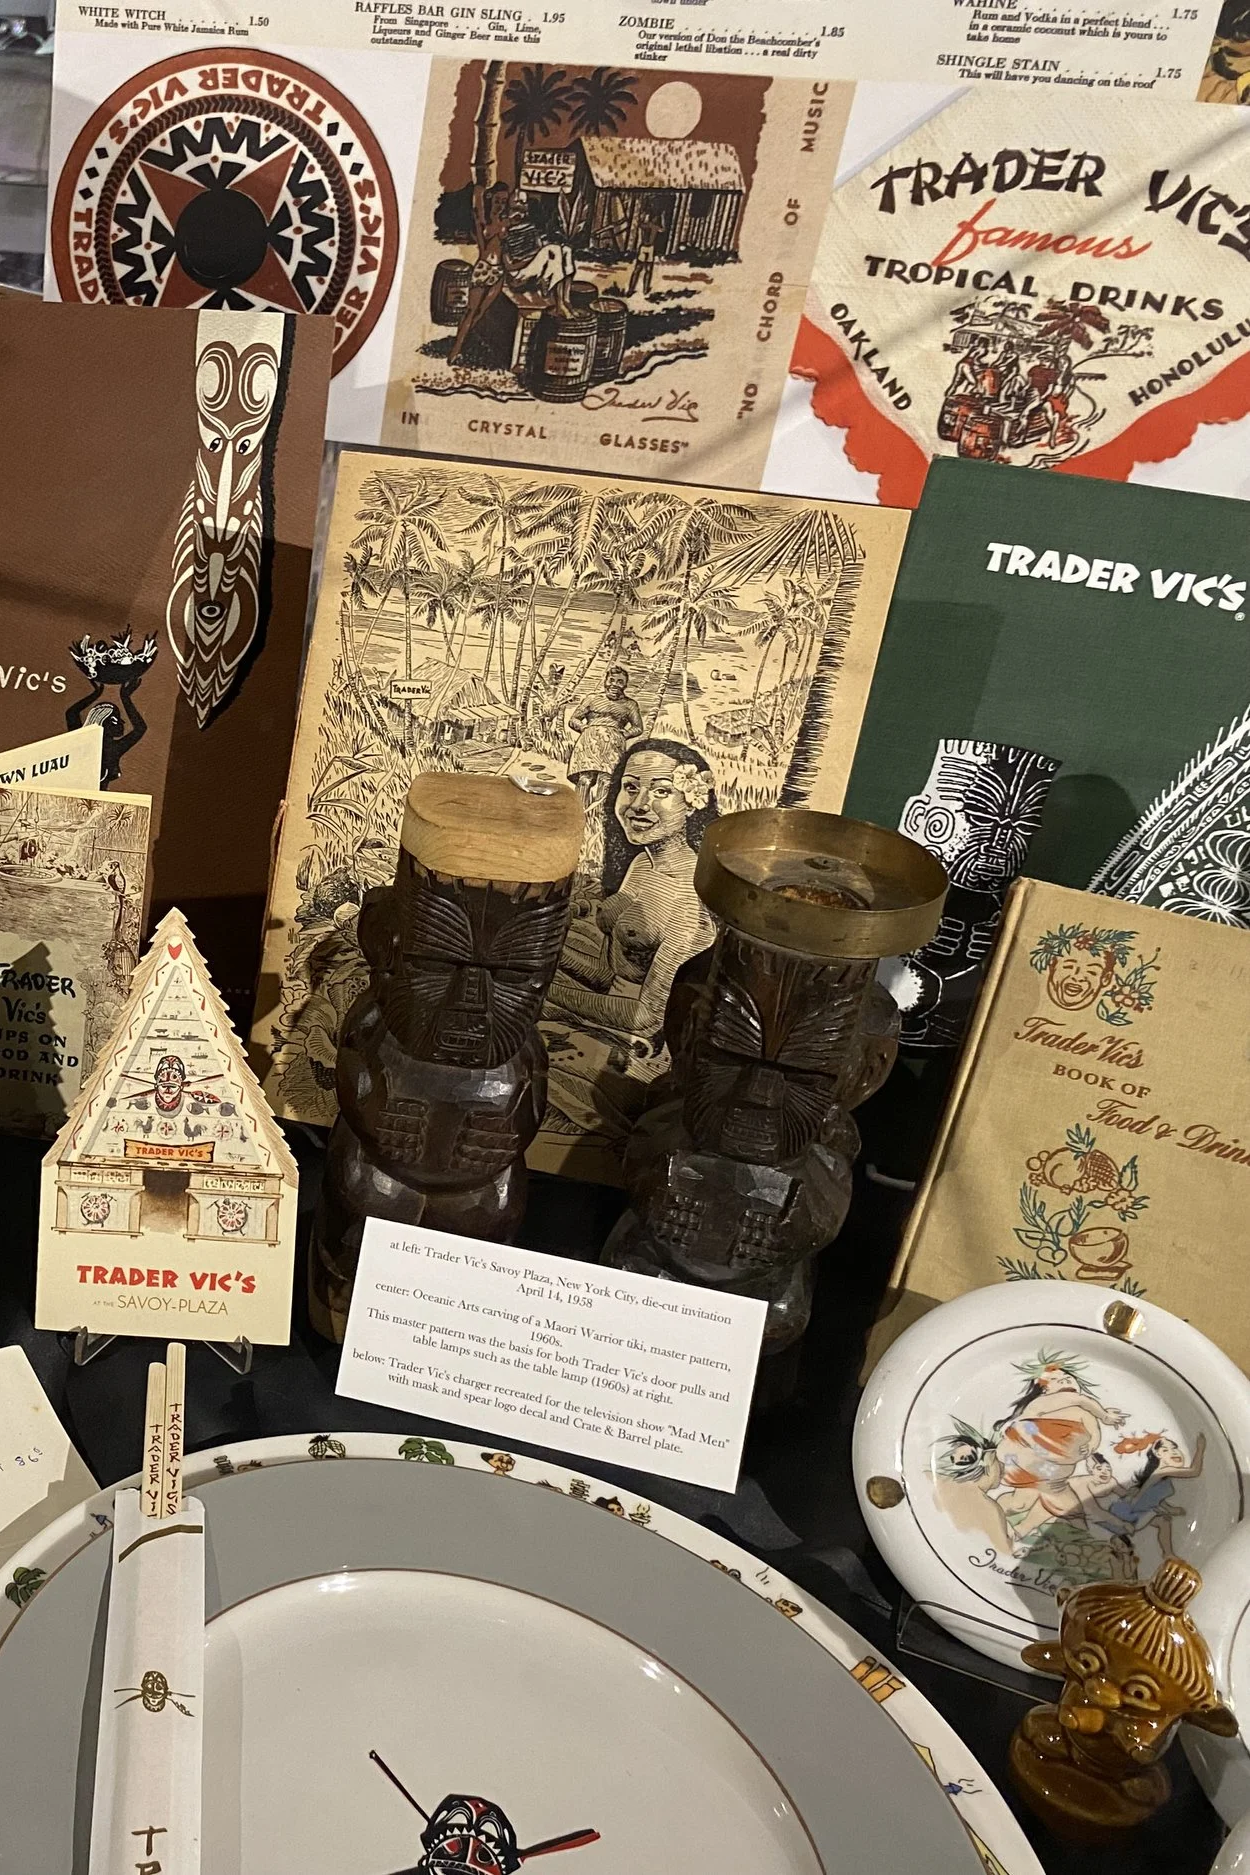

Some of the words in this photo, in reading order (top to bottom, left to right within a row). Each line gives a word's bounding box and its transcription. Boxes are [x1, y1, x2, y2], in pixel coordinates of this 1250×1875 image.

[78, 6, 119, 19] WHITE
[125, 8, 166, 21] WITCH
[249, 16, 269, 27] 1.50
[355, 2, 412, 15] RAFFLES
[418, 5, 444, 17] BAR
[450, 7, 475, 19] GIN
[480, 9, 522, 21] SLING
[542, 12, 565, 23] 1.95
[619, 15, 675, 30] ZOMBIE
[820, 26, 845, 38] 1.85
[936, 54, 1007, 69] SHINGLE
[1012, 59, 1060, 71] STAIN
[1155, 68, 1182, 79] 1.75
[959, 68, 981, 79] This
[984, 69, 1003, 80] will
[1005, 71, 1029, 82] have
[1033, 74, 1052, 85] you
[1054, 74, 1095, 87] dancing
[1098, 78, 1111, 87] on
[1114, 78, 1130, 88] the
[1133, 79, 1156, 89] roof
[870, 147, 1106, 215] TRADER
[931, 197, 1152, 267] famous
[737, 383, 758, 421] "NO
[756, 271, 784, 343] CHORD
[784, 197, 801, 226] OF
[799, 82, 828, 154] MUSIC
[864, 254, 1039, 297] TROPICAL
[1069, 281, 1224, 321] DRINKS
[830, 302, 913, 411] OAKLAND
[1128, 318, 1250, 406] HONOLULU
[401, 411, 419, 427] IN
[467, 419, 547, 440] CRYSTAL
[599, 433, 690, 454] GLASSES"
[986, 542, 1141, 594] TRADER
[1150, 568, 1247, 612] VIC'S
[32, 754, 70, 778] LUAU
[38, 1034, 67, 1048] ON
[1013, 1016, 1100, 1057] Trader
[1099, 1035, 1144, 1070] Vic's
[39, 1052, 79, 1068] AND
[1053, 1063, 1116, 1090] BOOK
[1121, 1082, 1151, 1099] OF
[1086, 1098, 1160, 1135] Food
[1154, 1122, 1178, 1140] &
[136, 1146, 175, 1156] TRADER
[178, 1147, 203, 1158] VIC'S
[77, 1265, 178, 1289] TRADER
[190, 1270, 257, 1294] VIC'S
[390, 1241, 399, 1250] at
[401, 1241, 421, 1254] left:
[425, 1246, 461, 1263] Trader
[464, 1255, 486, 1269] Vic's
[488, 1261, 520, 1279] Savoy
[522, 1267, 553, 1286] Plaza,
[555, 1275, 581, 1290] New
[585, 1281, 611, 1297] York
[614, 1289, 639, 1305] City,
[641, 1295, 678, 1312] die-cut
[680, 1303, 731, 1324] invitation
[516, 1283, 544, 1297] April
[547, 1289, 563, 1302] 14,
[566, 1293, 593, 1308] 1958
[118, 1295, 229, 1316] SAVOY-PLAZA
[530, 1330, 562, 1347] 1960s.
[148, 1424, 163, 1485] TRADER
